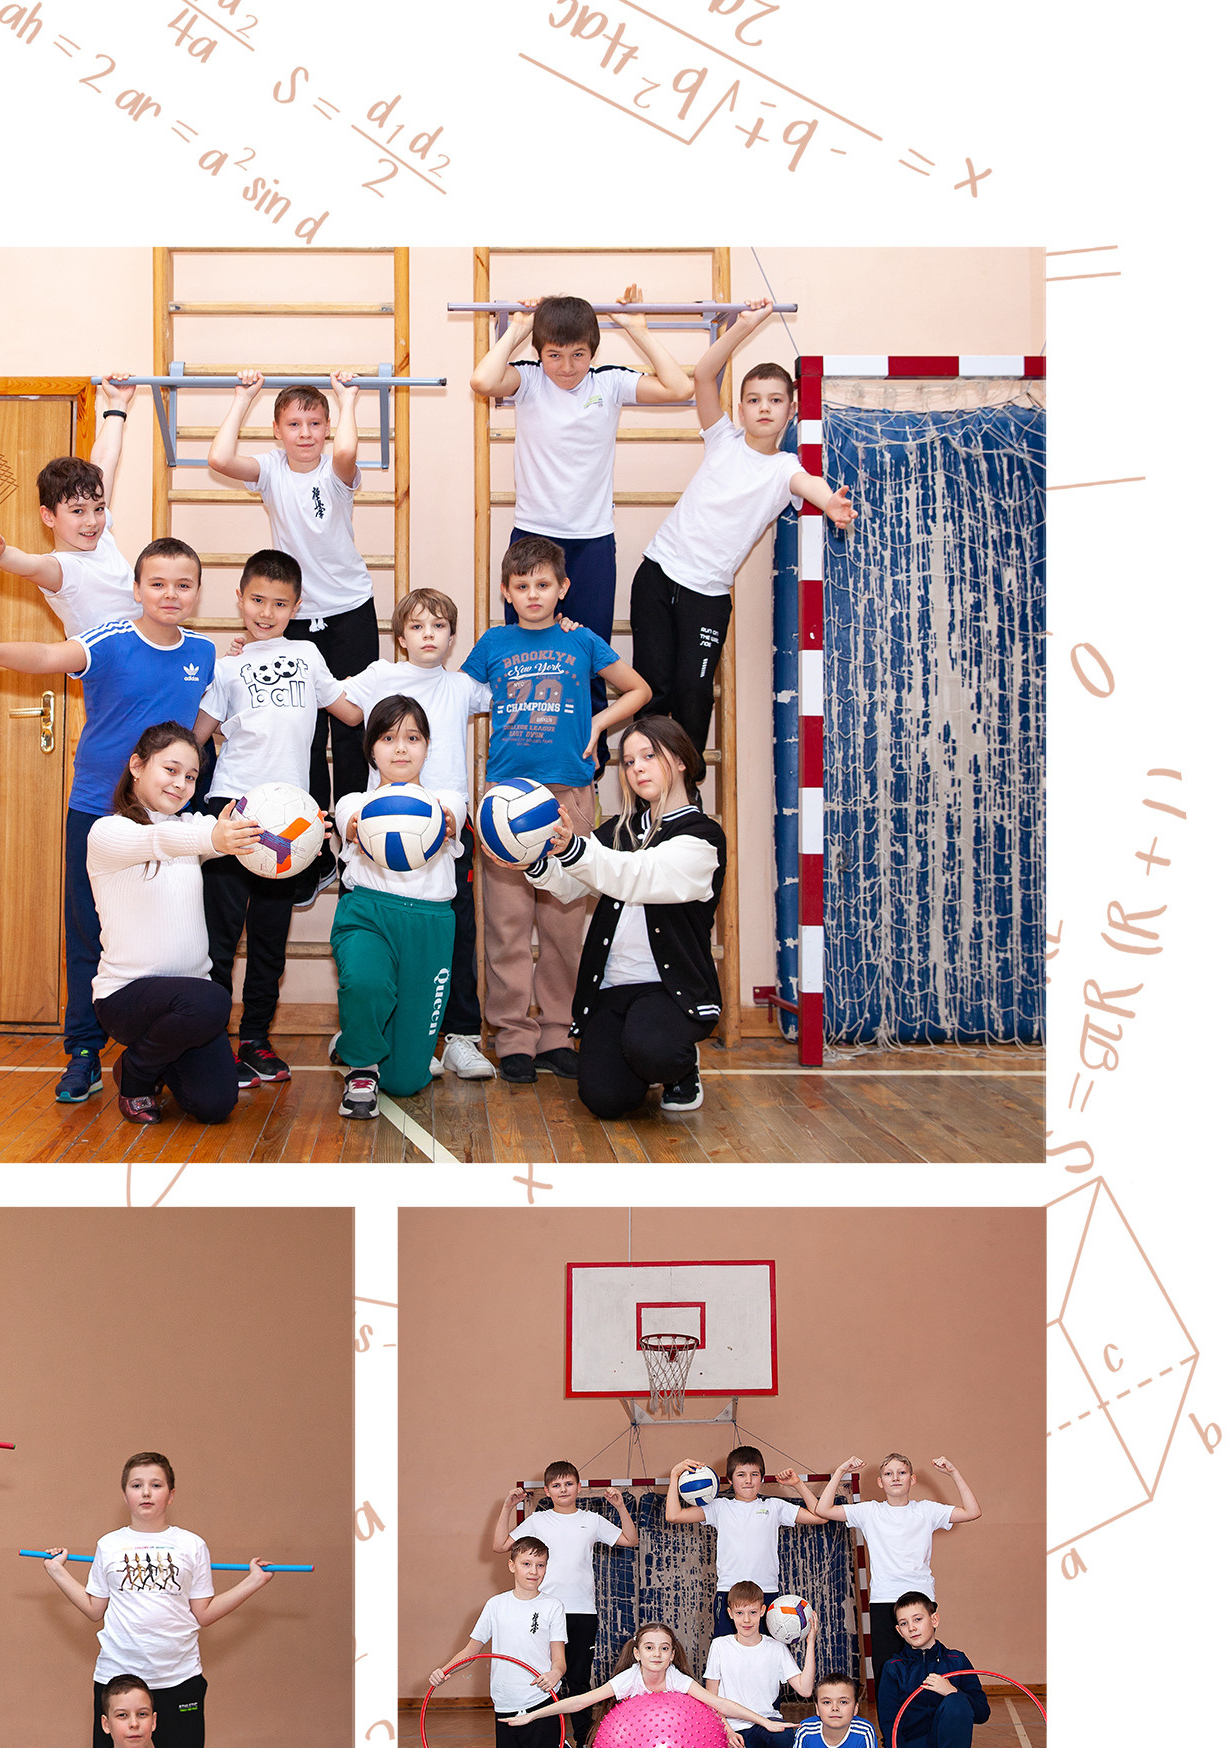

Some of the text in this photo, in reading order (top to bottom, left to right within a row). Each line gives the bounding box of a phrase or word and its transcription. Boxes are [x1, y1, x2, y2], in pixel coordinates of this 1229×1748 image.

[503, 650, 576, 669] BROOKLYN
[508, 662, 564, 677] New York
[248, 680, 306, 708] ball
[506, 702, 561, 713] CHAMPIONS
[428, 967, 450, 1036] Queen
